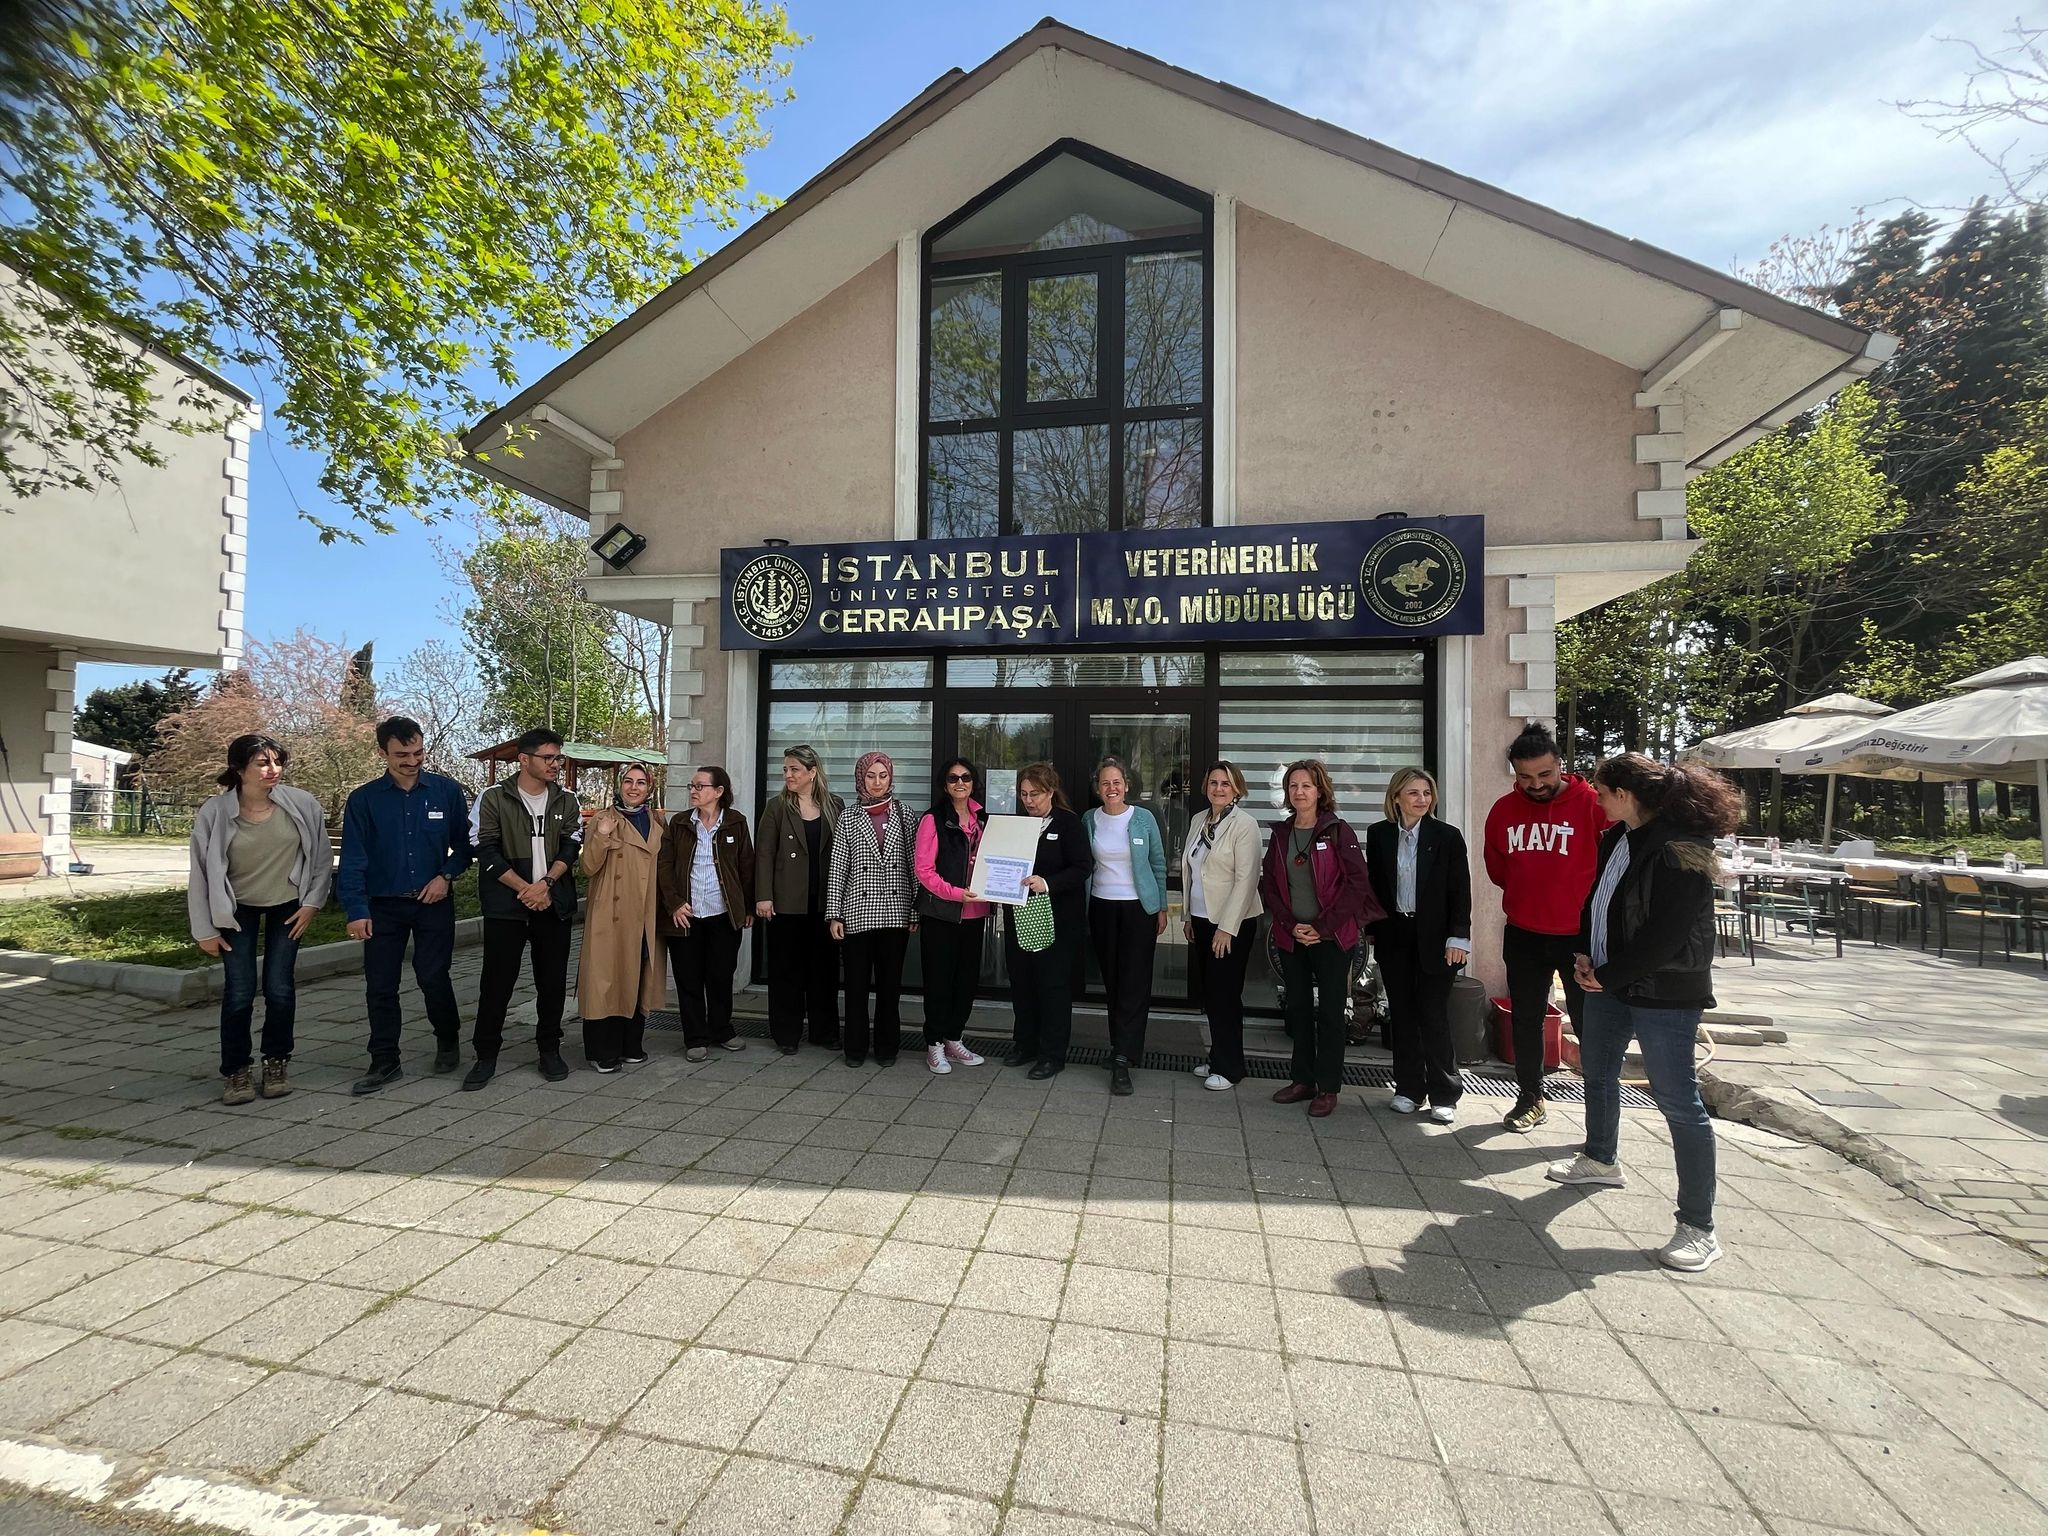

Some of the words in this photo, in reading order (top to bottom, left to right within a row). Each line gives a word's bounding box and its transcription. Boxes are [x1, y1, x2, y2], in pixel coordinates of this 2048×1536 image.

[821, 549, 1059, 584] İSTANBUL
[1124, 537, 1319, 578] VETERİNERLİK
[735, 559, 772, 602] İSTANBUL
[774, 557, 810, 624] ÜNİVERSİTESİ
[830, 580, 1050, 602] ÜNİVERSİTESİ
[1090, 596, 1170, 626] M.Y.O.
[1179, 584, 1356, 623] MÜDÜRLÜĞÜ
[1404, 600, 1423, 610] 2002
[761, 627, 784, 637] 1453
[818, 603, 1061, 639] CERRAHPAŞA
